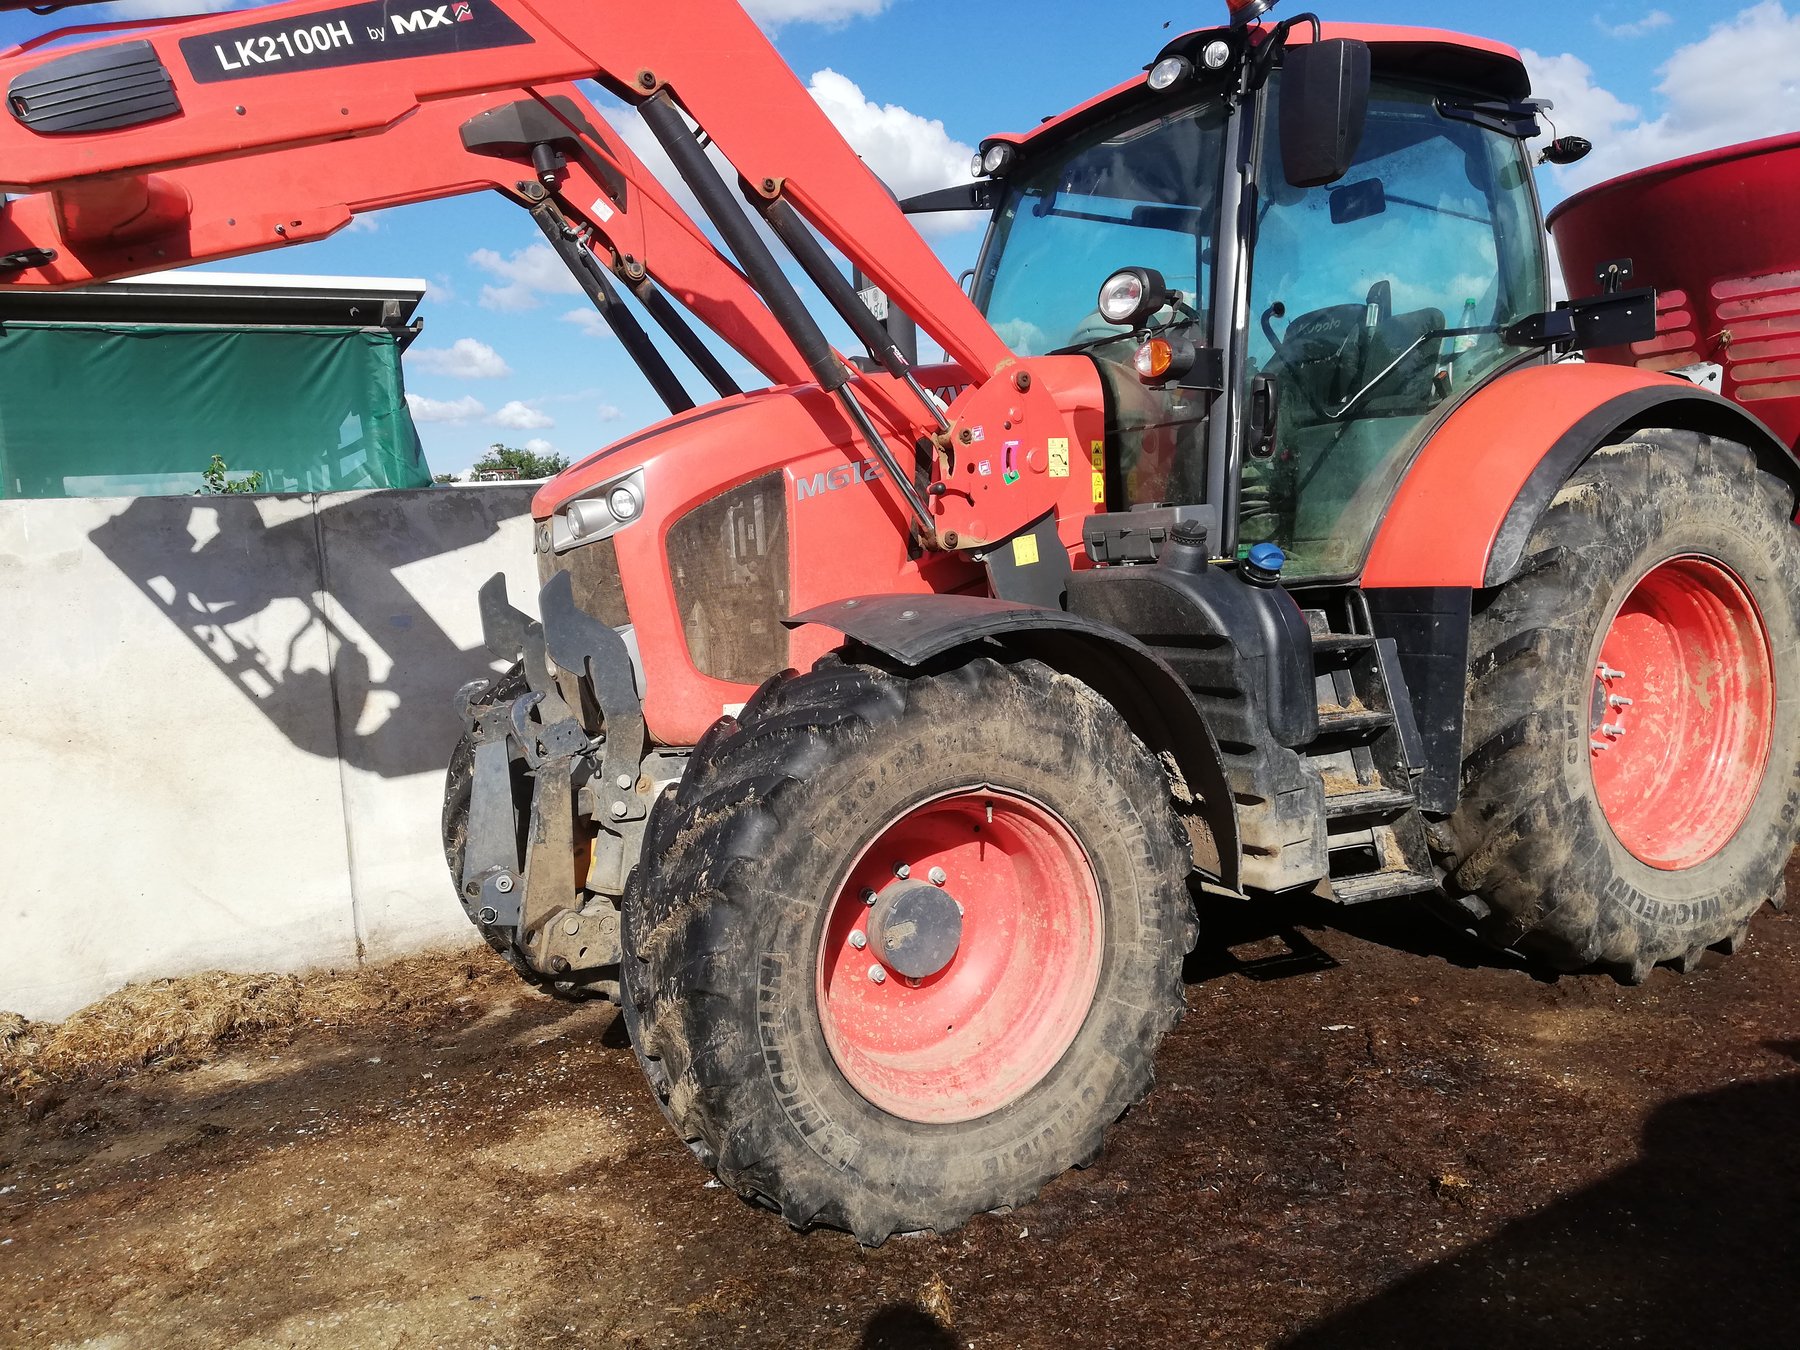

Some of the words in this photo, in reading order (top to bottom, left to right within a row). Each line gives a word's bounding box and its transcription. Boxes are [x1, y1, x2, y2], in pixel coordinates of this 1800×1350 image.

[214, 20, 354, 71] LK2100H
[366, 25, 386, 42] by
[390, 5, 453, 35] MX
[1296, 318, 1341, 335] Kubota
[1607, 875, 1721, 926] MICHELIN
[758, 954, 828, 1139] MICHELIN
